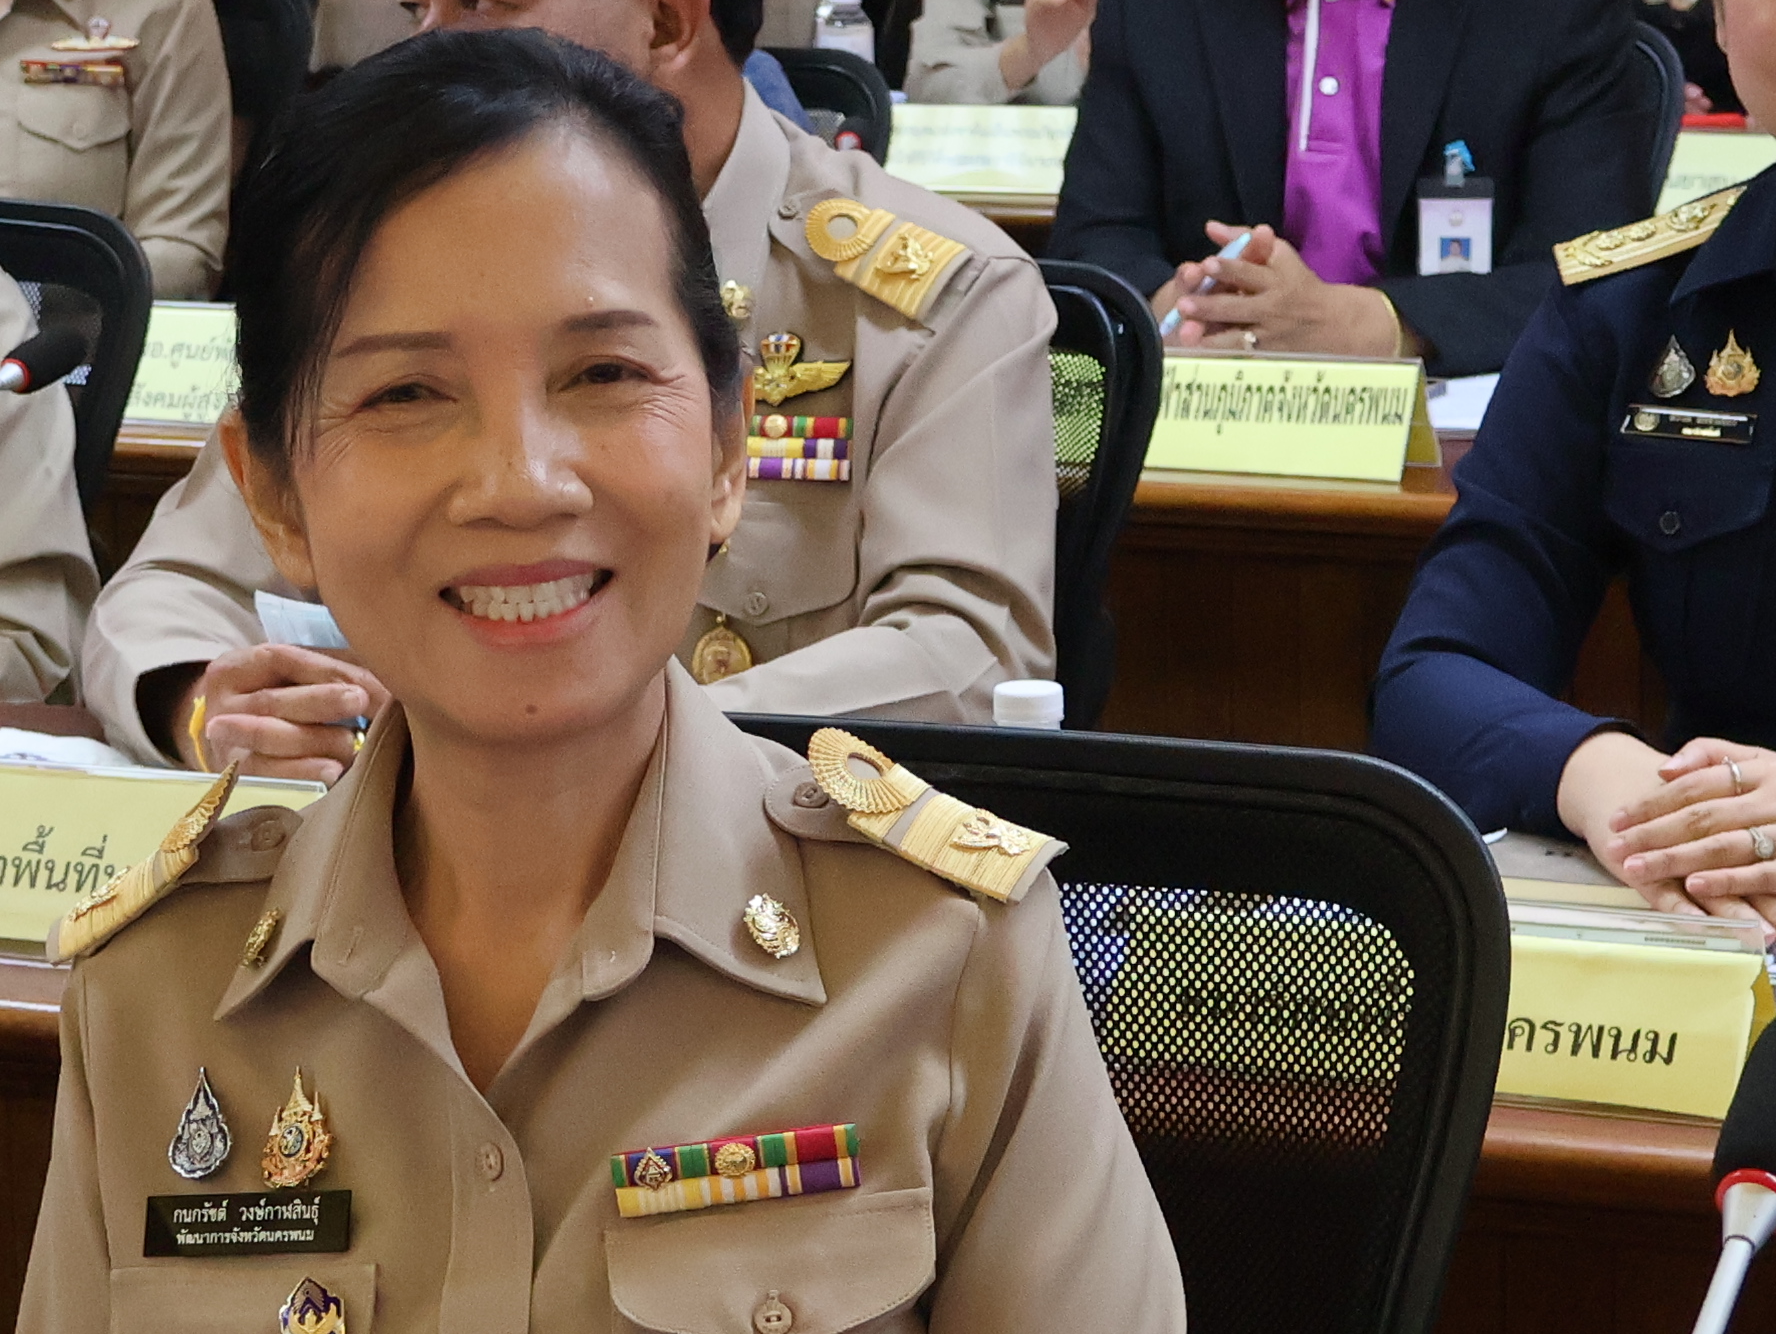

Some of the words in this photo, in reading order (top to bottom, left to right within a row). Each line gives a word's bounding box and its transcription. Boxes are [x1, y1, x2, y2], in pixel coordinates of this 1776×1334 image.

[1506, 1016, 1678, 1066] ครพนม
[176, 1227, 315, 1246] พัฒนาการจังหวัดนครพนม
